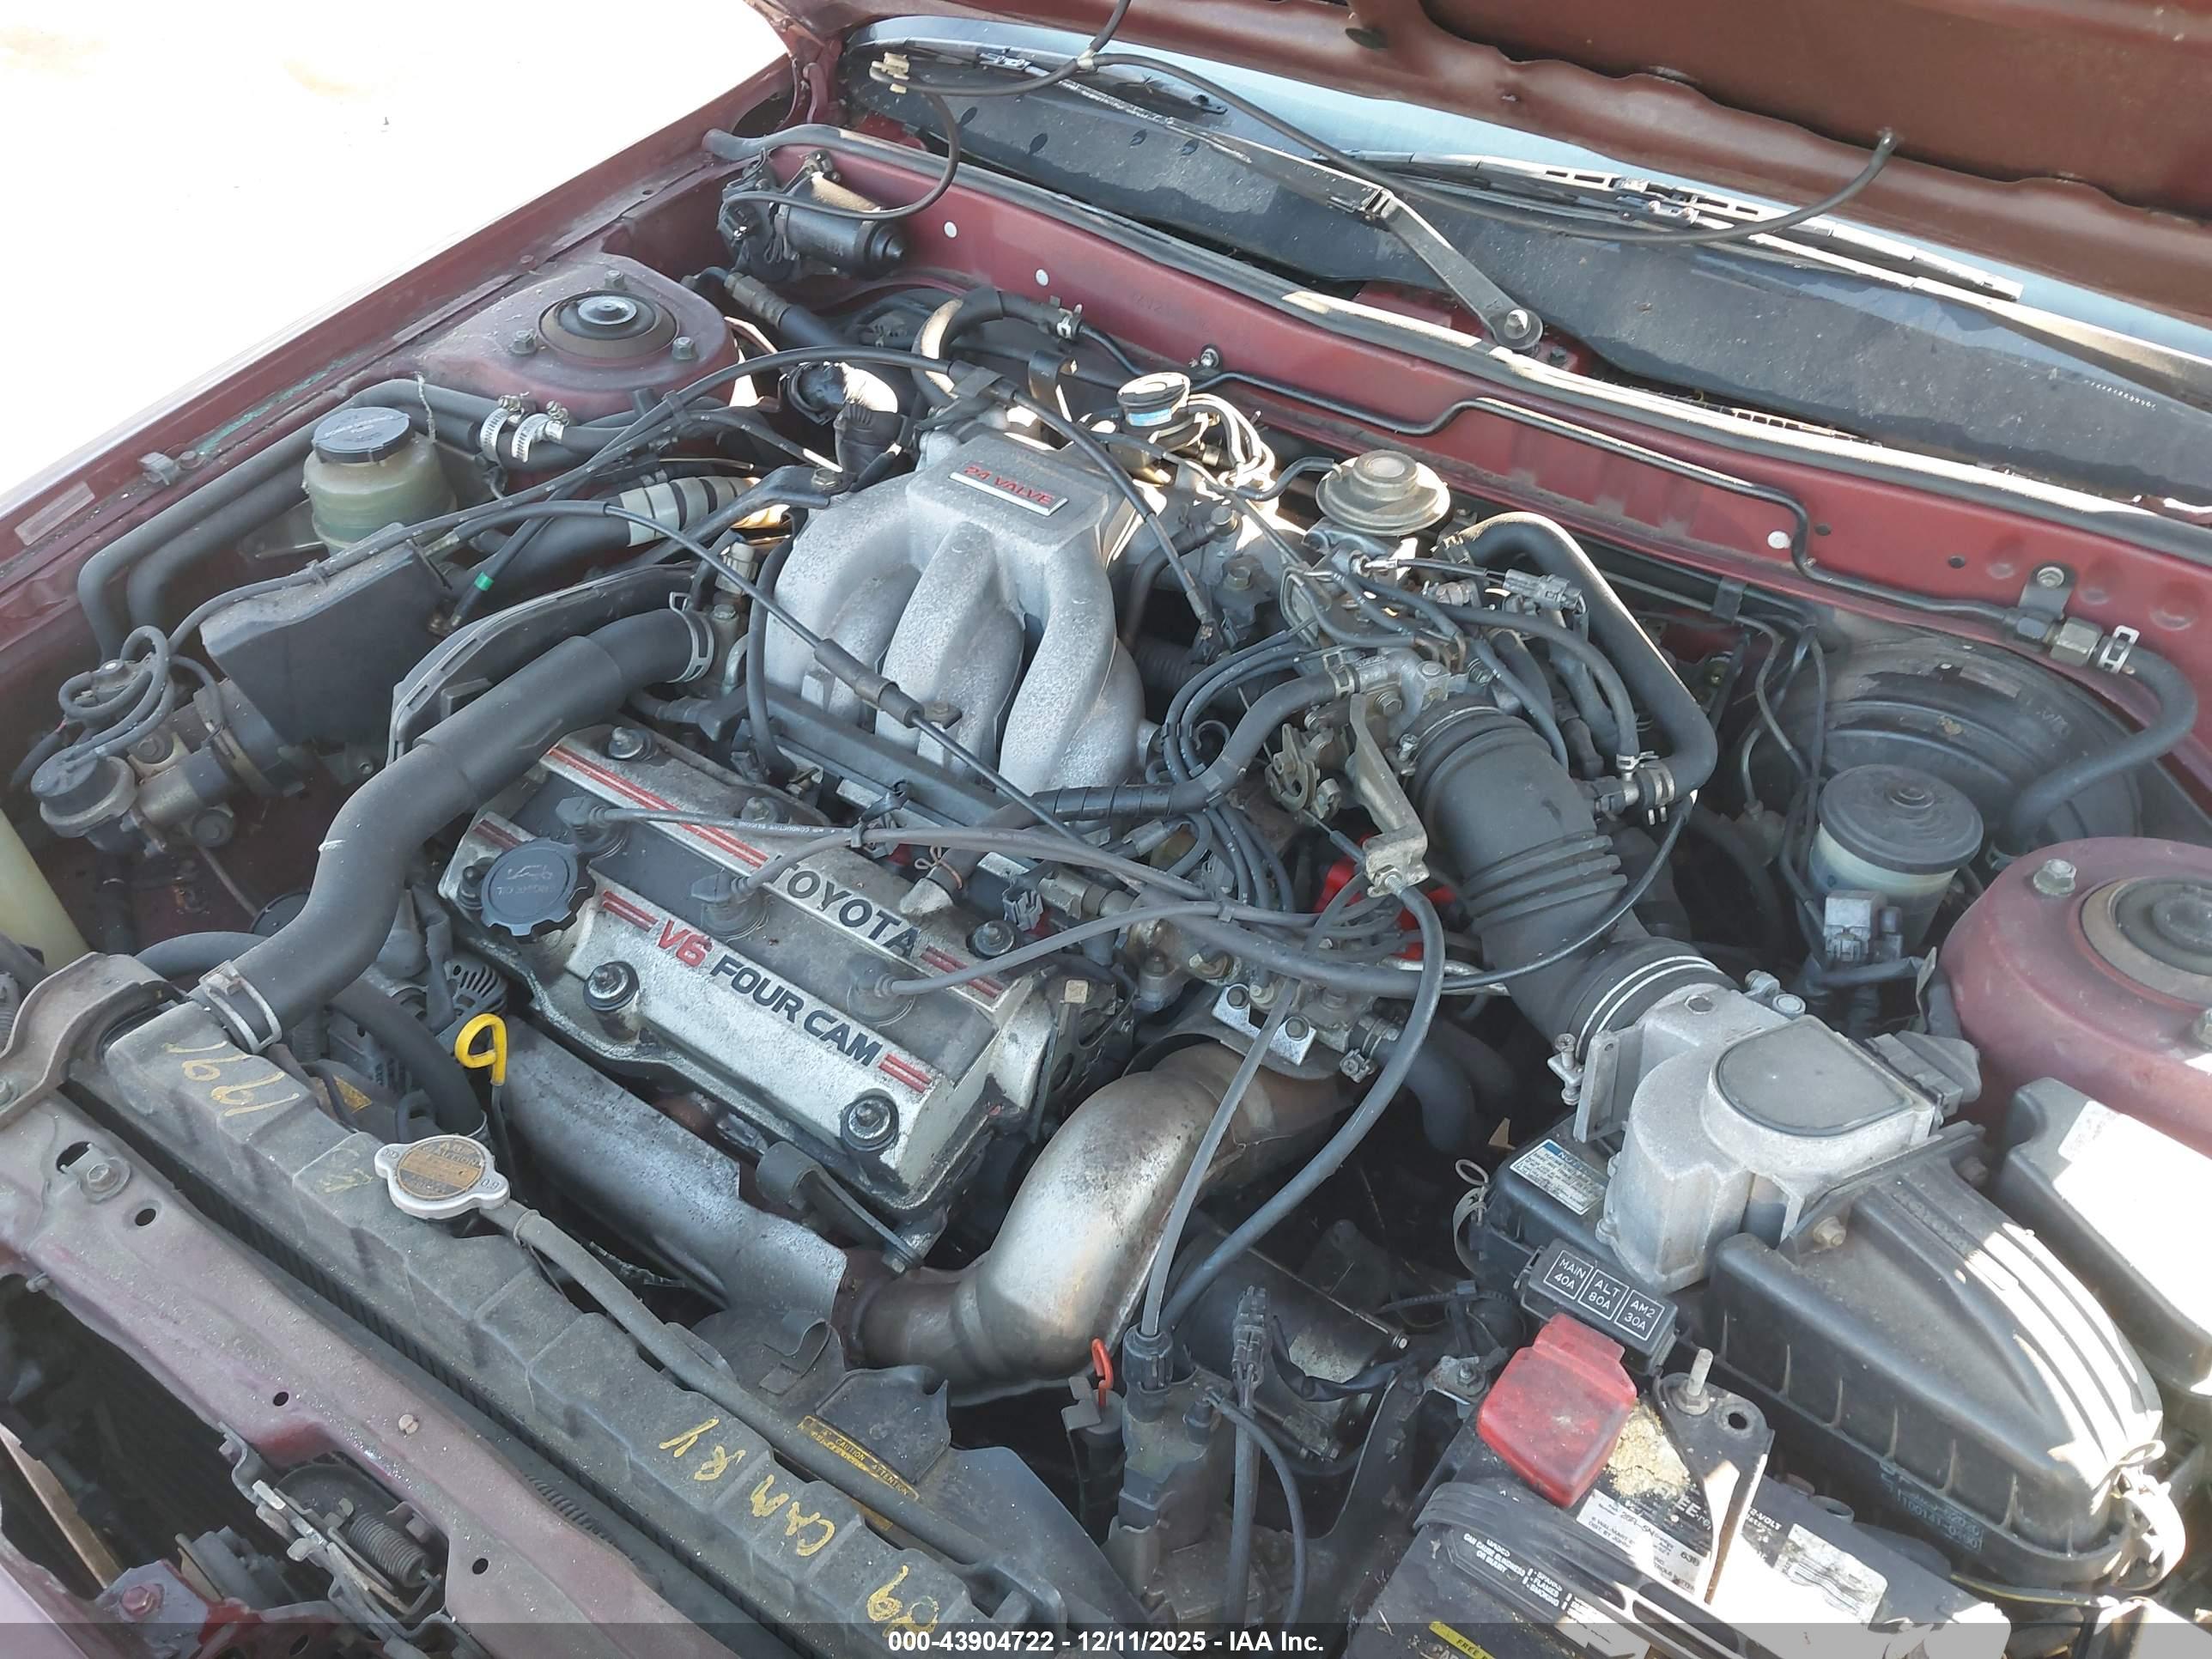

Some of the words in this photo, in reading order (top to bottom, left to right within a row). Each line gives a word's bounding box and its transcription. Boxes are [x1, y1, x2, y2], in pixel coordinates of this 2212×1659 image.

[964, 465, 992, 480] 24
[994, 476, 1055, 504] VALVE
[767, 854, 921, 958] TOYOTA
[656, 920, 714, 968] V6
[710, 955, 805, 1023] FOUR
[804, 1010, 883, 1066] CAM
[1559, 1259, 1586, 1279] MAIN
[1554, 1273, 1576, 1290] 40A
[1595, 1279, 1621, 1297] ALT
[1589, 1291, 1610, 1310] 80A
[1630, 1300, 1656, 1319] AM2
[1624, 1313, 1646, 1331] 30A
[836, 1438, 866, 1462] CAUTION
[872, 1462, 908, 1496] ATTENTION
[1463, 1533, 1478, 1547] CAN
[1476, 1540, 1496, 1556] CAUSE
[1528, 1585, 1560, 1607] SMOKING
[1533, 1577, 1560, 1598] FLAMES
